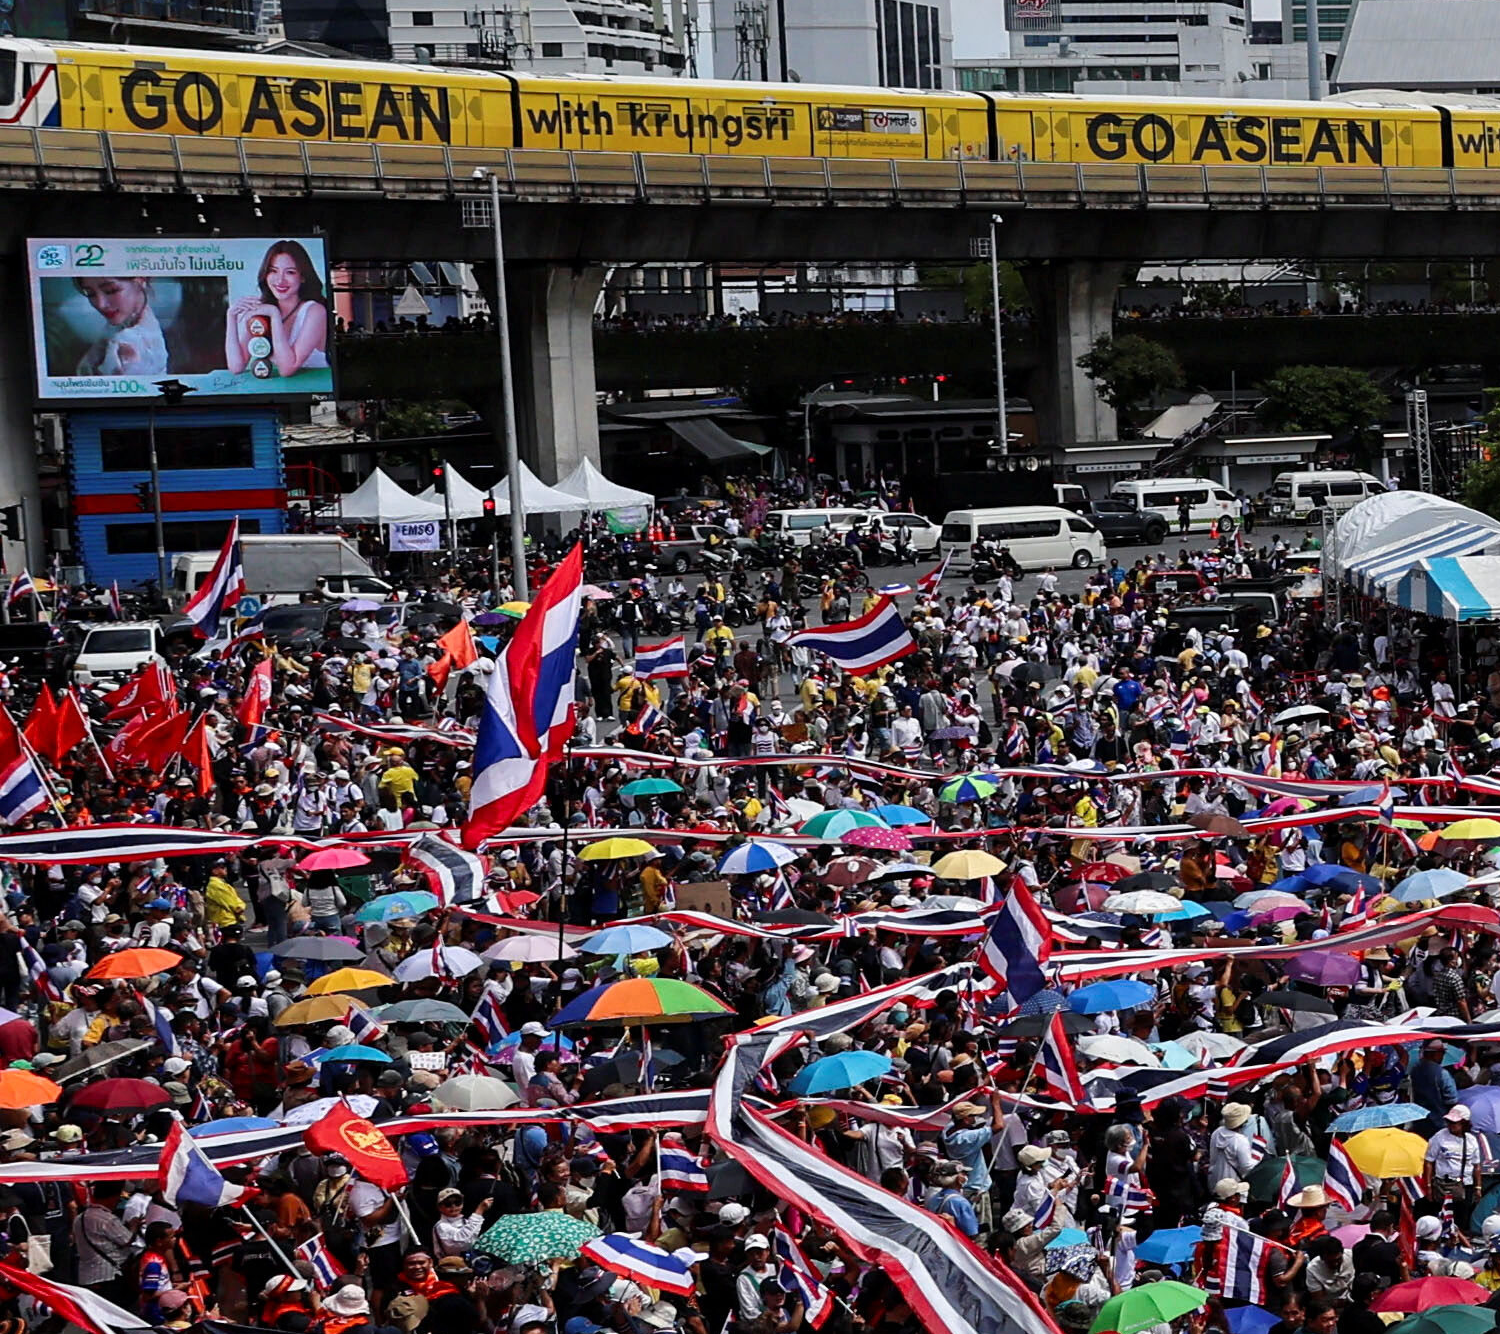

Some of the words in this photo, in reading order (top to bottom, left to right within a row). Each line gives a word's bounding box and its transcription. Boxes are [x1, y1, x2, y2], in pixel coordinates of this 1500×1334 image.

[121, 68, 223, 133] GO
[241, 75, 449, 145] ASEAN
[527, 99, 615, 136] with
[629, 101, 790, 147] krungsri
[1086, 113, 1175, 161] GO
[1192, 115, 1381, 165] ASEAN
